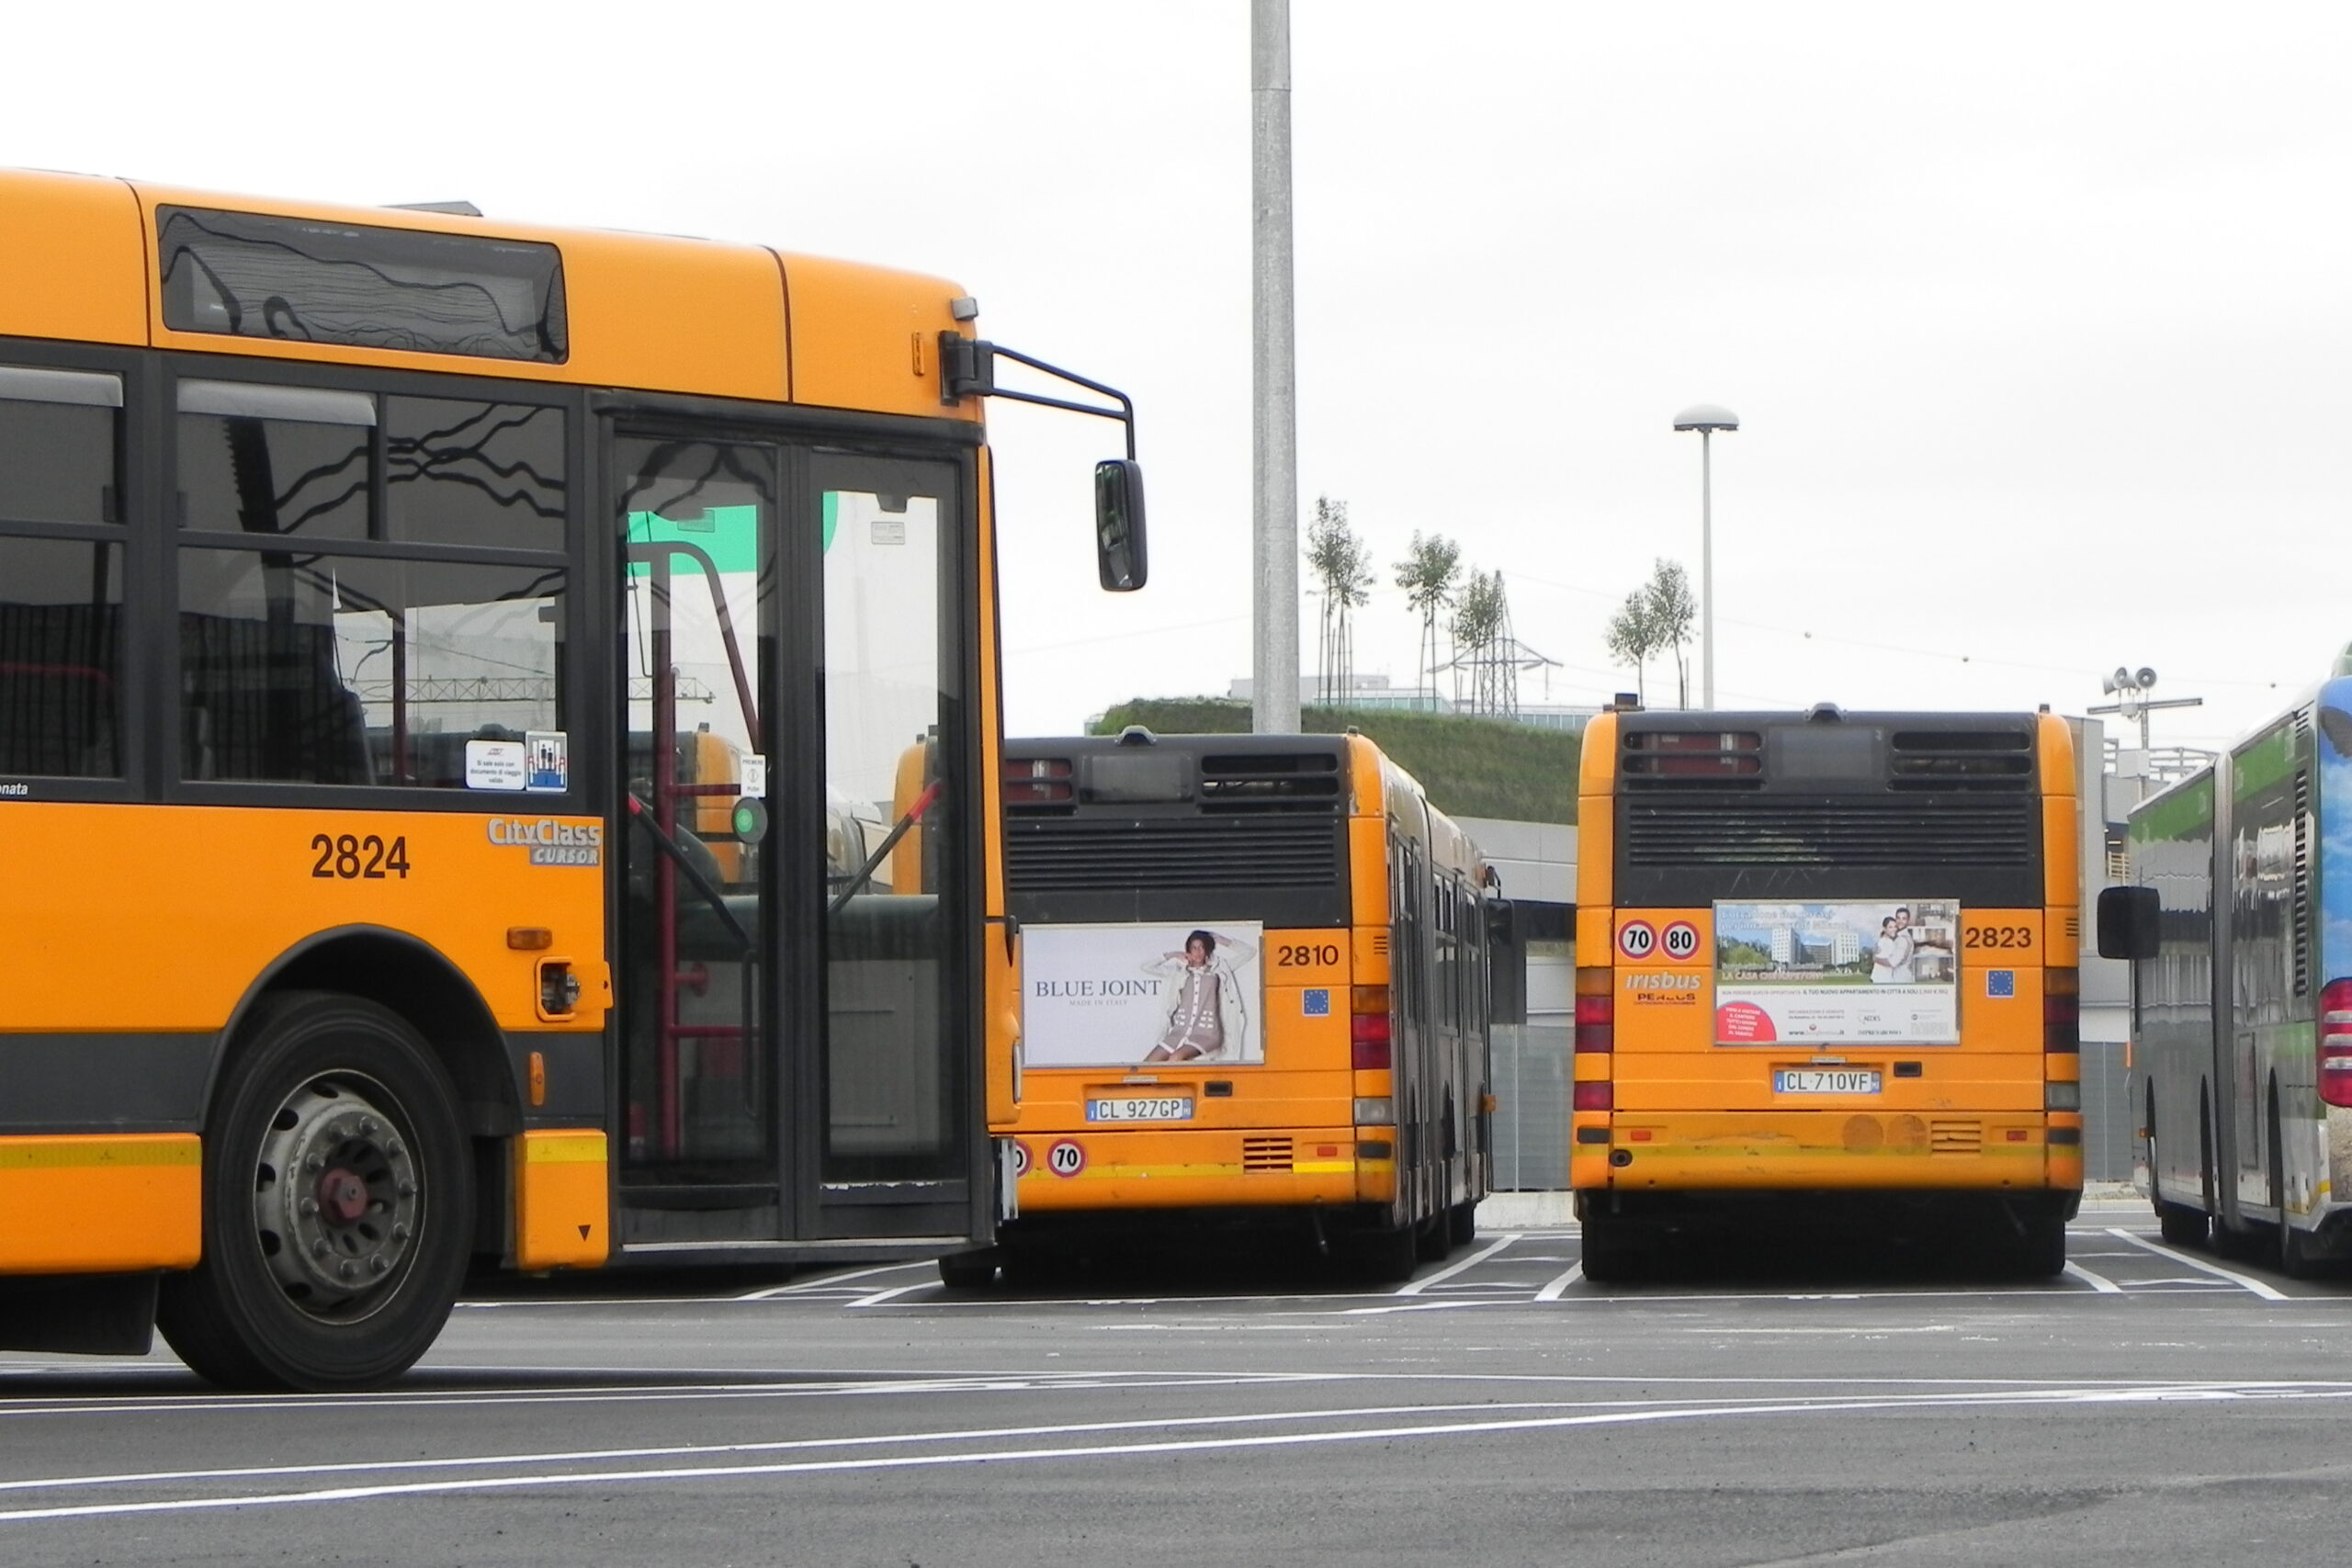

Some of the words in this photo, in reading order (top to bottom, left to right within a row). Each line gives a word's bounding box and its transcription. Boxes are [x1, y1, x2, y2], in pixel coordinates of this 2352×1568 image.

[0, 783, 28, 795] nata
[488, 818, 601, 846] CityClass
[311, 833, 411, 879] 2824
[532, 849, 600, 863] CURSOR
[1628, 930, 1649, 948] 70
[1669, 931, 1691, 949] 80
[1965, 927, 2031, 948] 2823
[1278, 944, 1340, 966] 2810
[1035, 980, 1094, 998] BLUE
[1099, 979, 1162, 997] JOINT
[1787, 1073, 1807, 1089] CL
[1815, 1073, 1868, 1090] 710VF
[1100, 1101, 1119, 1118] CL
[1126, 1100, 1181, 1118] 927GP
[1057, 1148, 1078, 1167] 70
